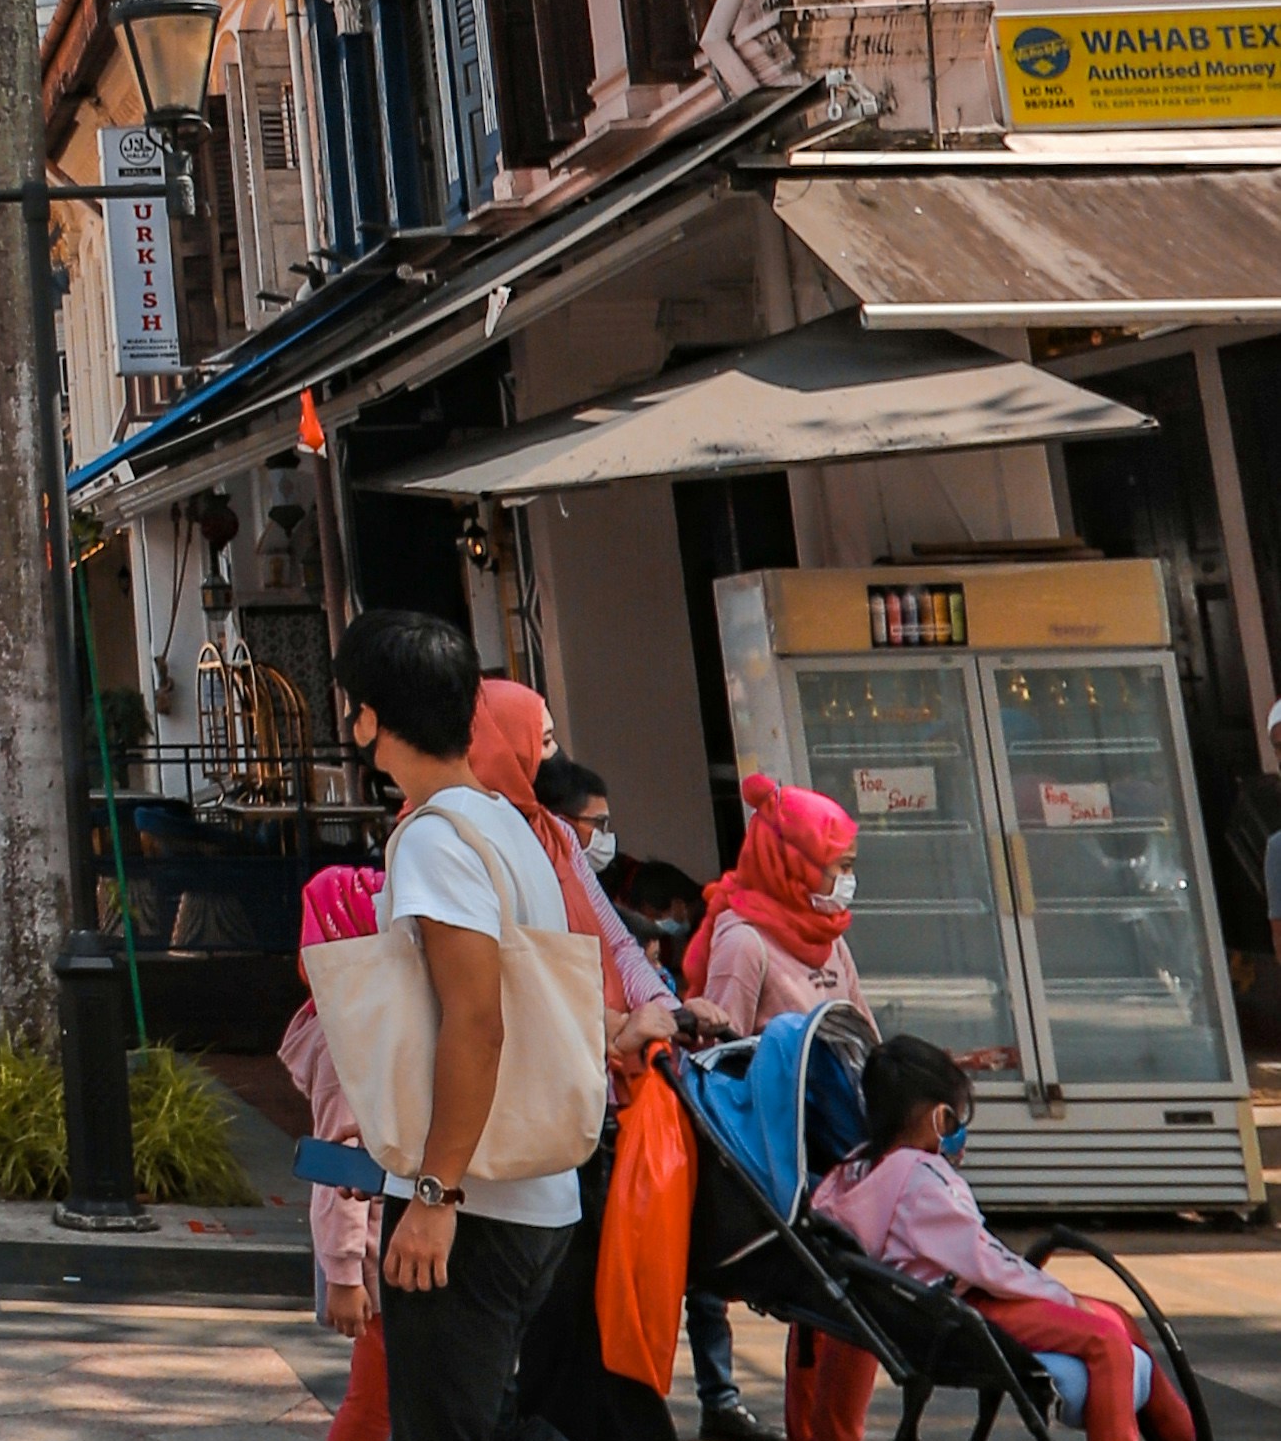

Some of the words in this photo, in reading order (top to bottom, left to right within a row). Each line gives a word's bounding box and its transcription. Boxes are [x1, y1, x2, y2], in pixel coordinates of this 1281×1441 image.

[1081, 26, 1211, 55] WAHAB
[1217, 23, 1281, 50] TEX
[1088, 63, 1201, 82] Authorised
[1206, 62, 1276, 79] Money
[133, 203, 163, 331] URKISH
